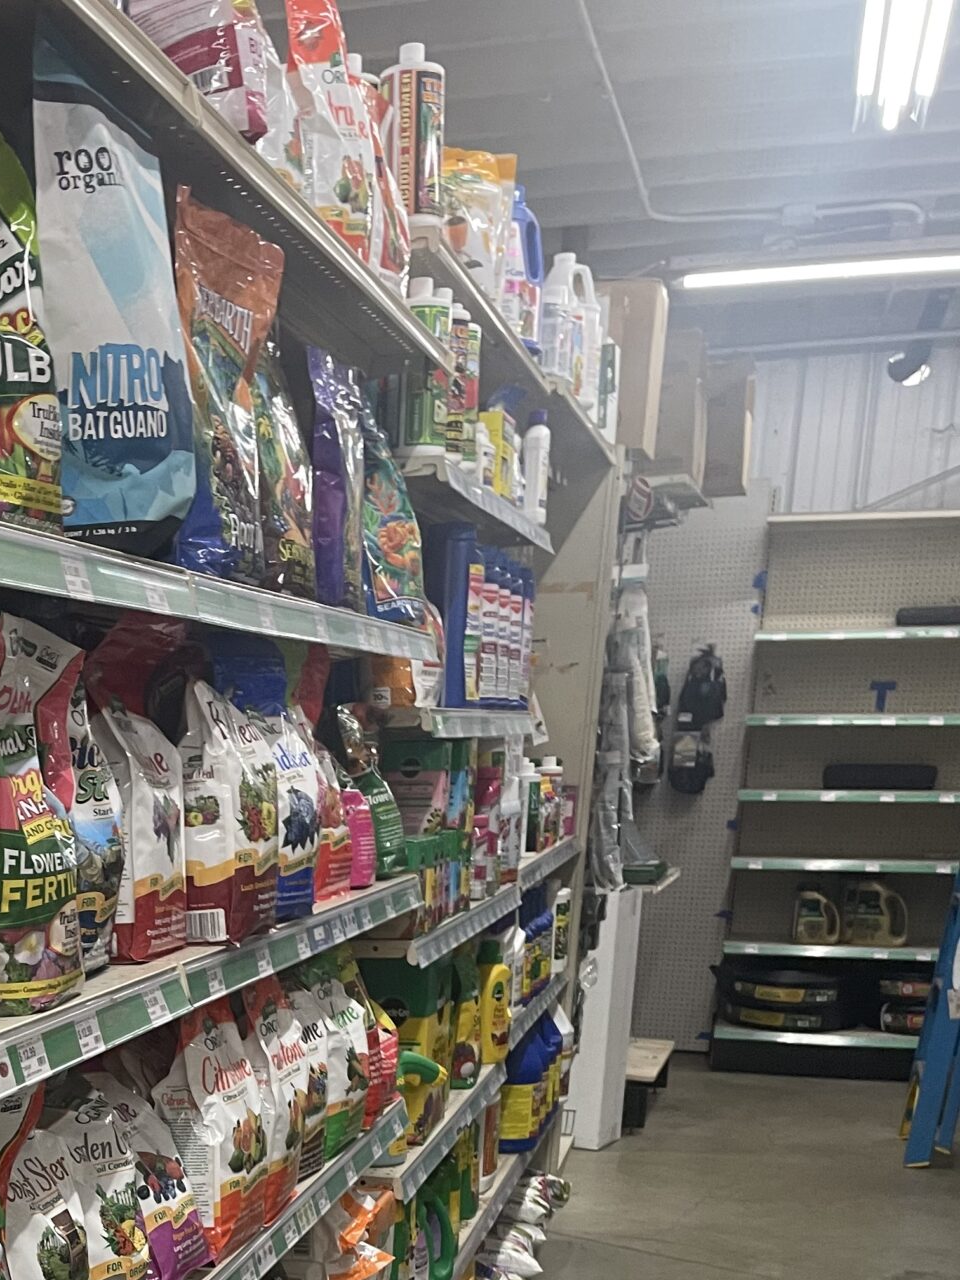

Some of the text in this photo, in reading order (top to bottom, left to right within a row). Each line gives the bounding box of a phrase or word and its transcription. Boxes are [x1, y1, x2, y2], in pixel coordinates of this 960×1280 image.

[66, 341, 170, 411] NITRO
[67, 408, 168, 447] BAT GUANO
[106, 1261, 124, 1276] FOR
